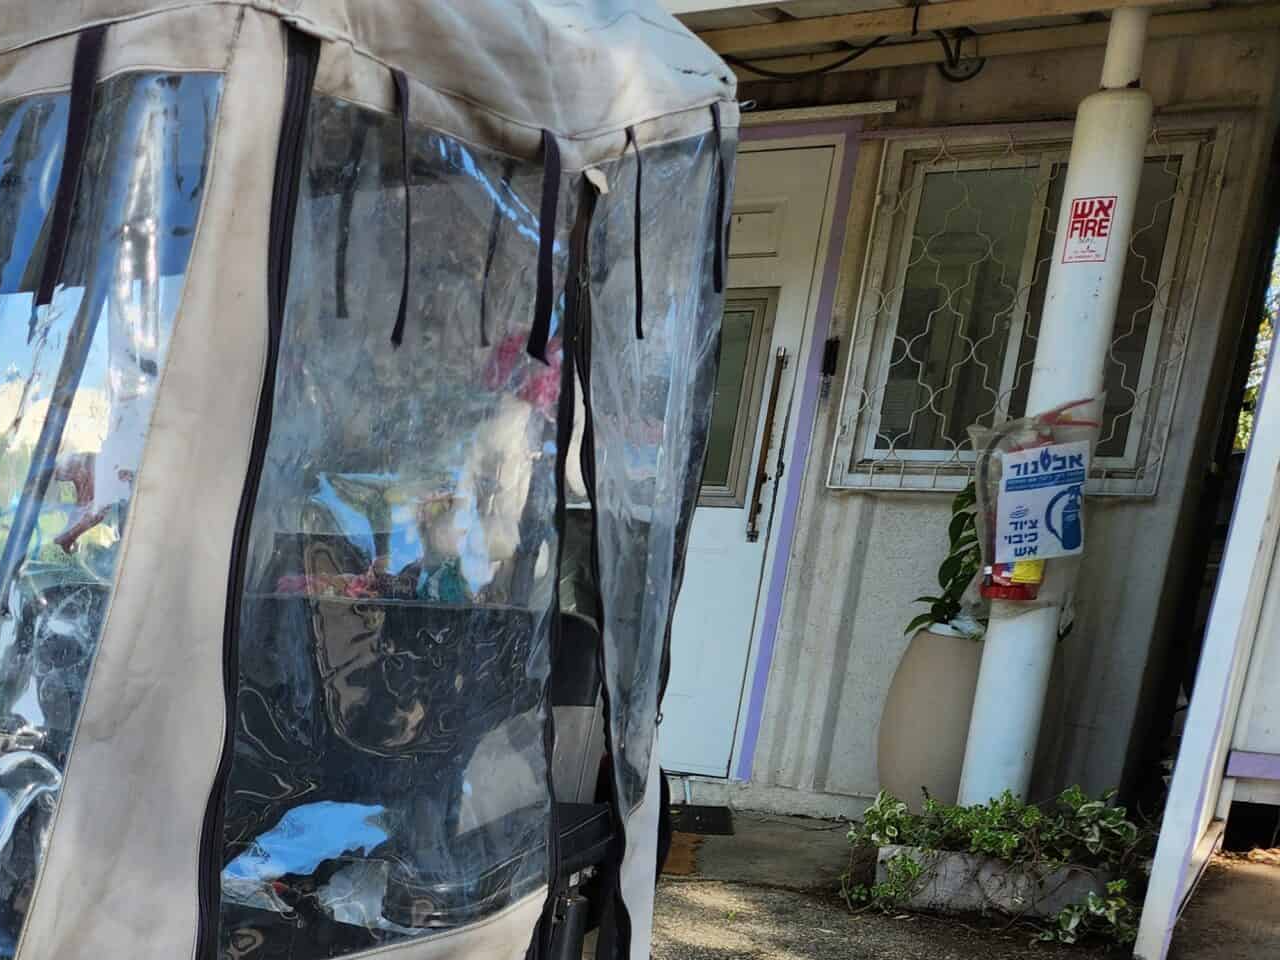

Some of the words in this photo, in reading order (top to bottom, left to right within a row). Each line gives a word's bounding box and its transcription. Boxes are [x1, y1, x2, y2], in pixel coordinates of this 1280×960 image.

[1072, 199, 1114, 219] אש
[1070, 218, 1110, 239] FIRE
[1008, 520, 1039, 531] ציוד
[1003, 532, 1039, 545] כיבוי
[1014, 545, 1038, 558] אש
